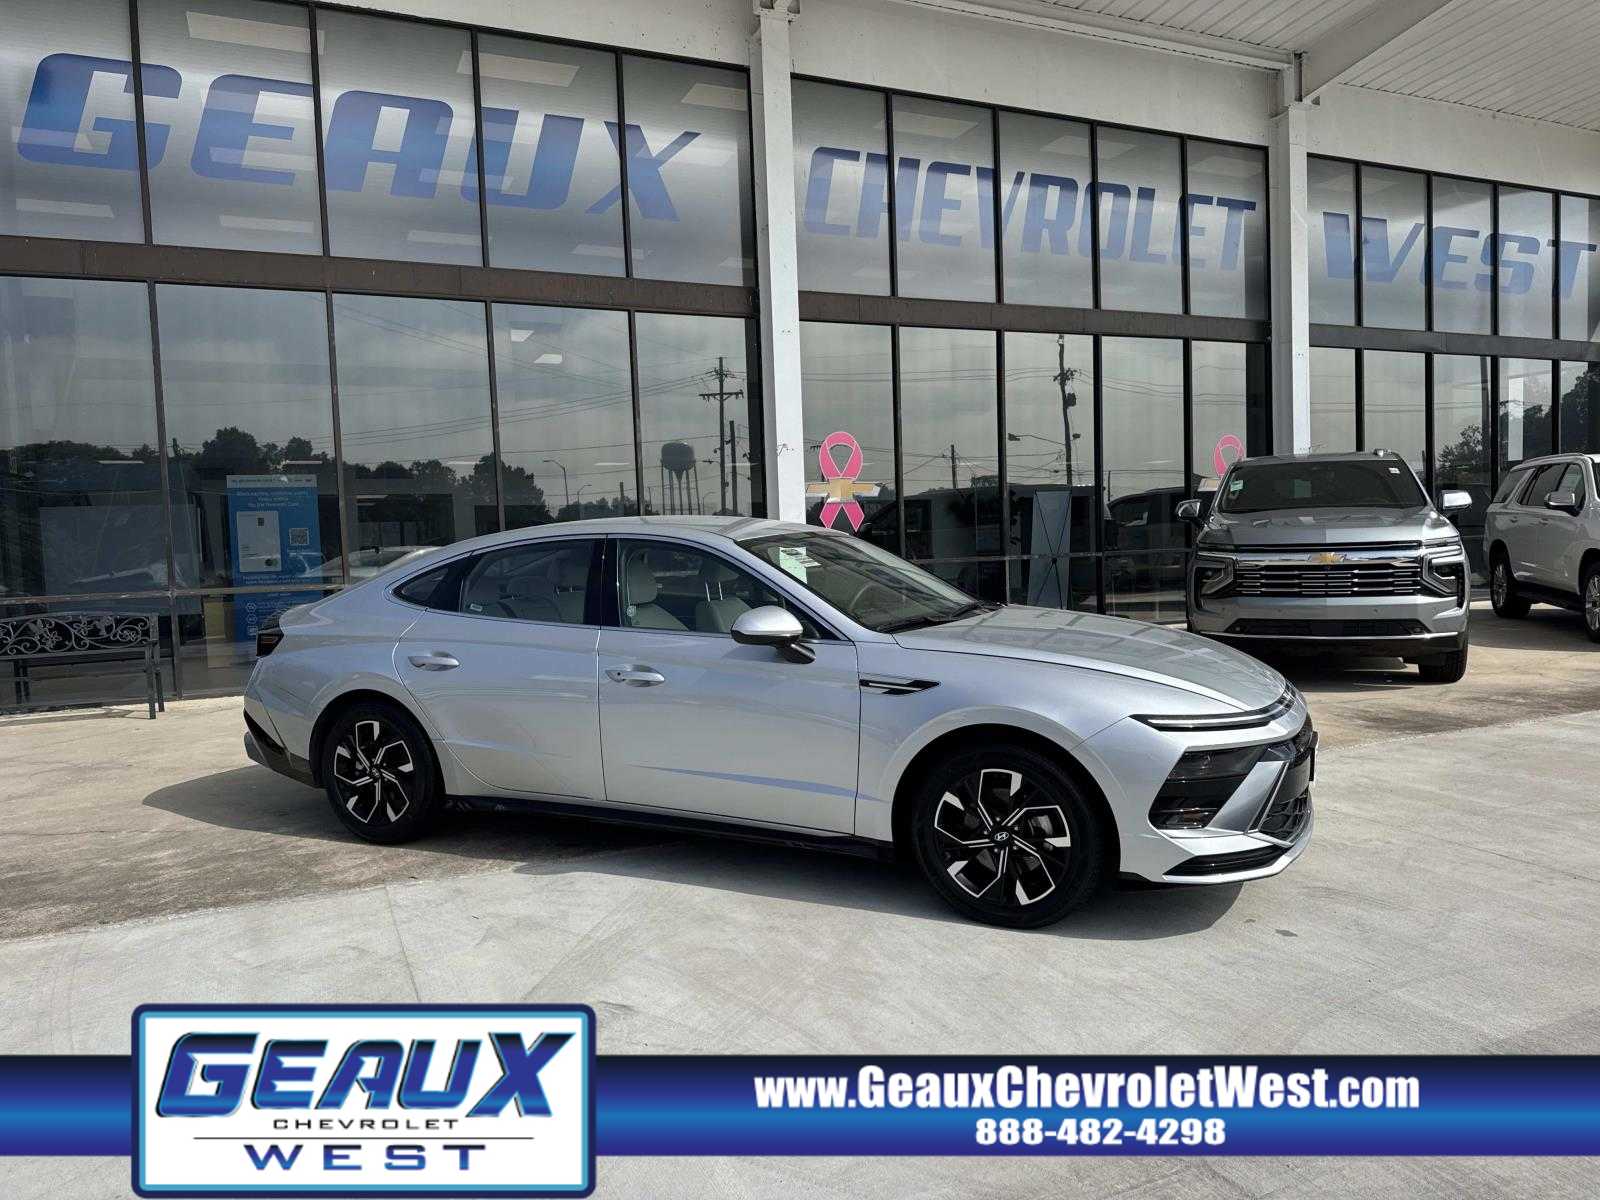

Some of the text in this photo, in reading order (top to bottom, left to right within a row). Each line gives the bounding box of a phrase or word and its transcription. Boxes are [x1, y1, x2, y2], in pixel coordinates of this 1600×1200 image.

[17, 52, 1598, 300] GEAUX CHEVROLET WEST
